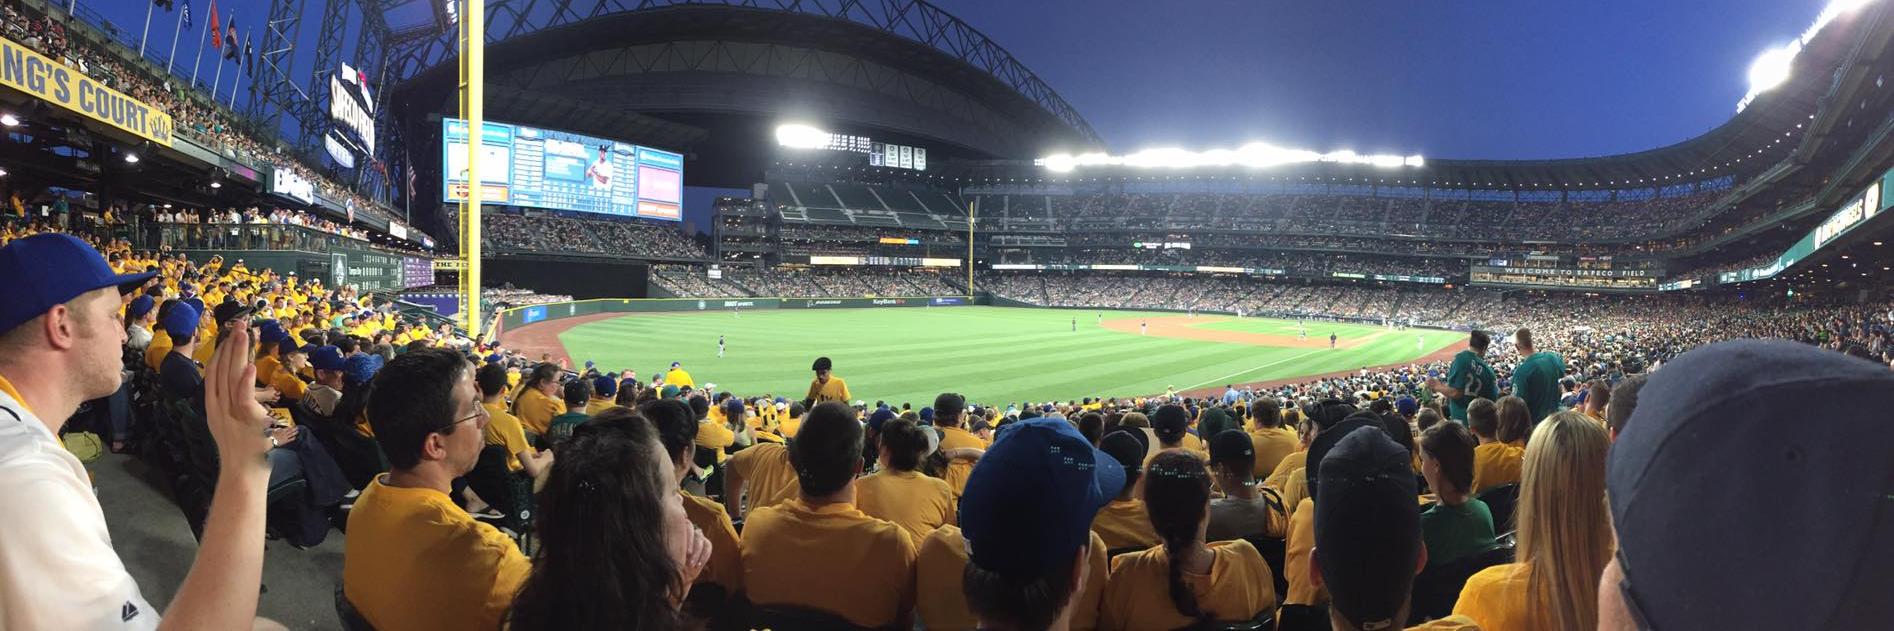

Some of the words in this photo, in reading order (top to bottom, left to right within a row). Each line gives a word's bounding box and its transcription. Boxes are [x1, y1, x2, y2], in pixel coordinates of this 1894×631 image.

[0, 44, 71, 104] NG'S
[79, 79, 149, 134] COURT
[1577, 269, 1613, 277] SAFECO
